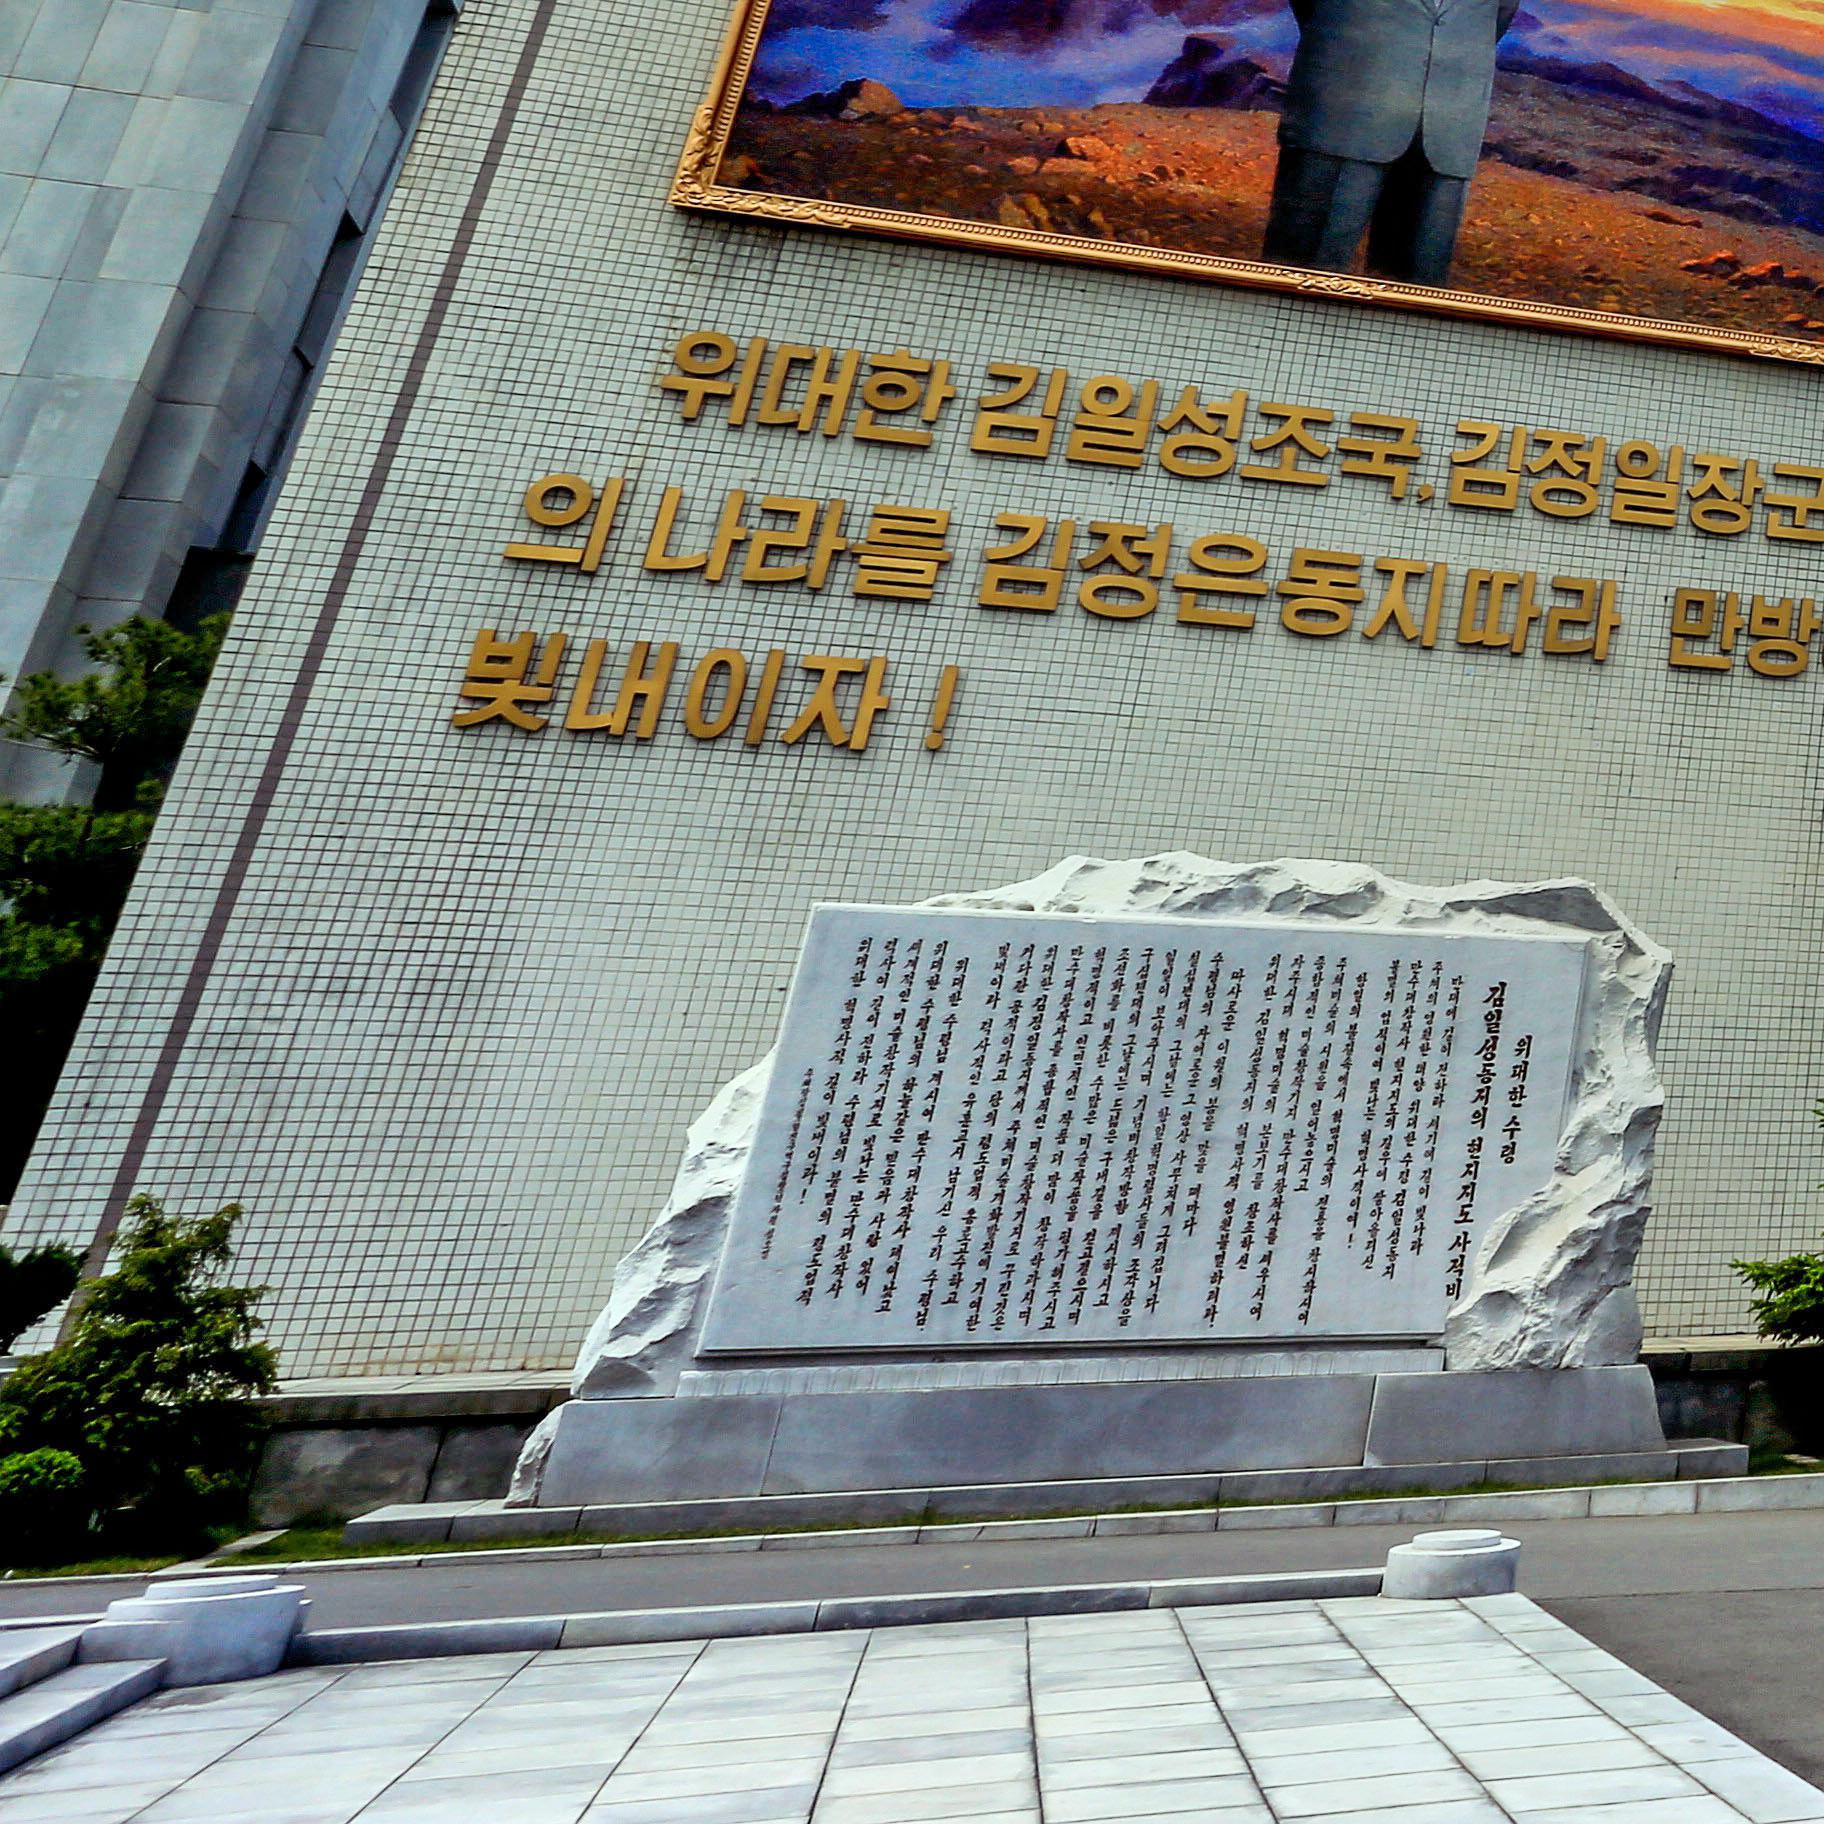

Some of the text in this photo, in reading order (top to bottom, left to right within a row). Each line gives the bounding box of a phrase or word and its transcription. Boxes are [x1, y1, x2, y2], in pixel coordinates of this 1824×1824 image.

[659, 331, 954, 449] 위대한
[502, 472, 626, 573] 의
[644, 488, 955, 602] 나라를
[1446, 982, 1506, 1301] 김일성동지의 현지지도 사적비
[1500, 1035, 1532, 1164] 위대한 수령
